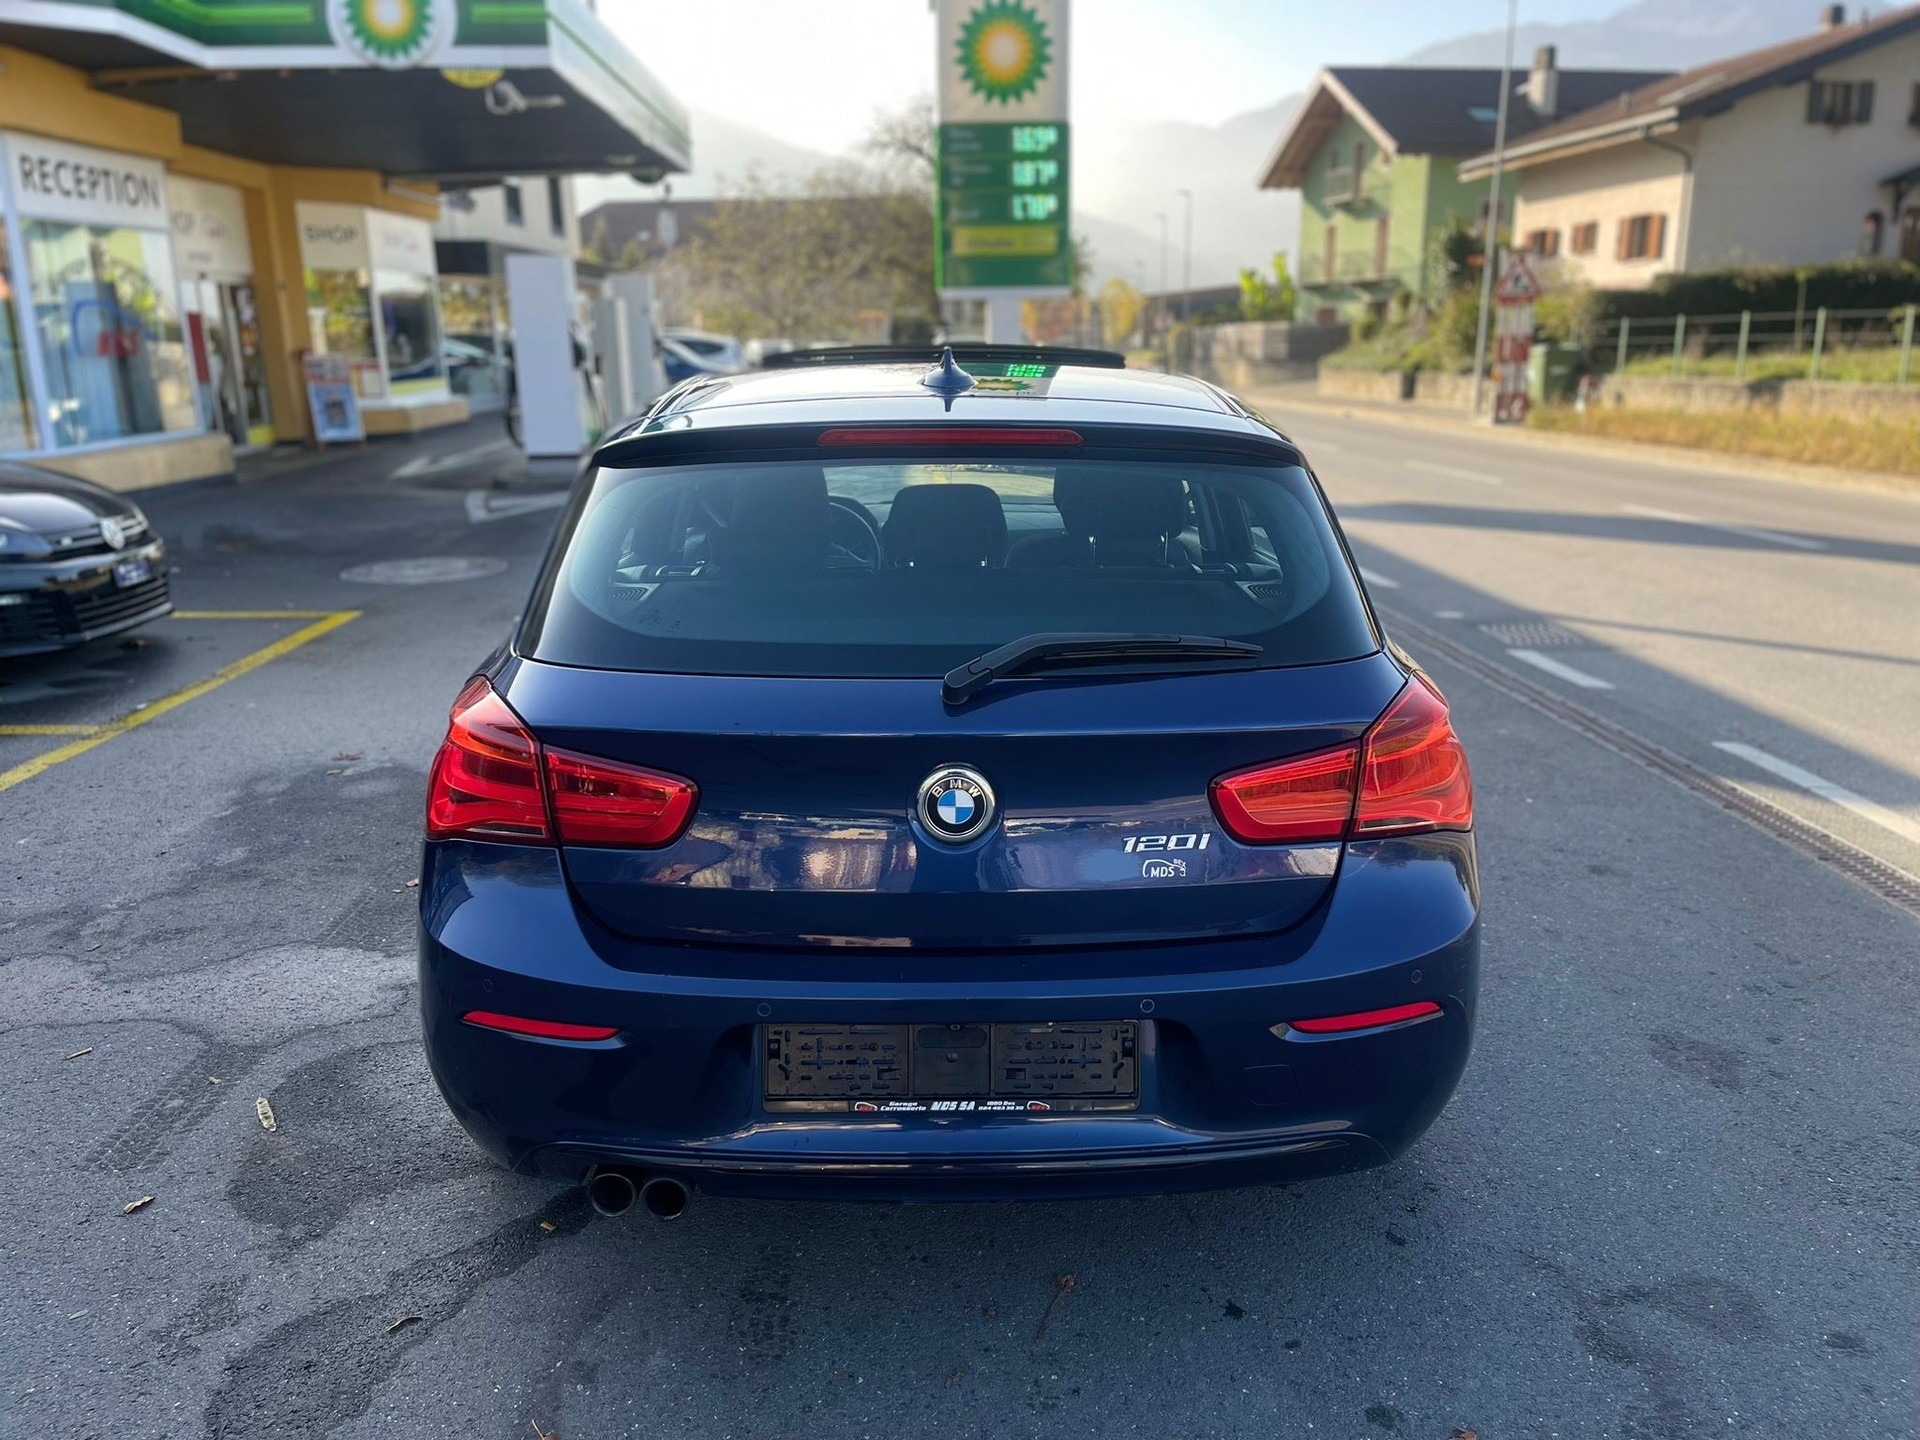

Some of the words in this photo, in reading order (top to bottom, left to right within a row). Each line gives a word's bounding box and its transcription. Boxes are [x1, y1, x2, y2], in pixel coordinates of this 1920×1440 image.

[18, 153, 162, 208] RECEPTION
[303, 223, 359, 244] SHOP
[931, 779, 981, 798] BMW
[1150, 866, 1175, 878] MDS
[930, 1101, 958, 1111] MDS
[958, 1101, 976, 1111] SA
